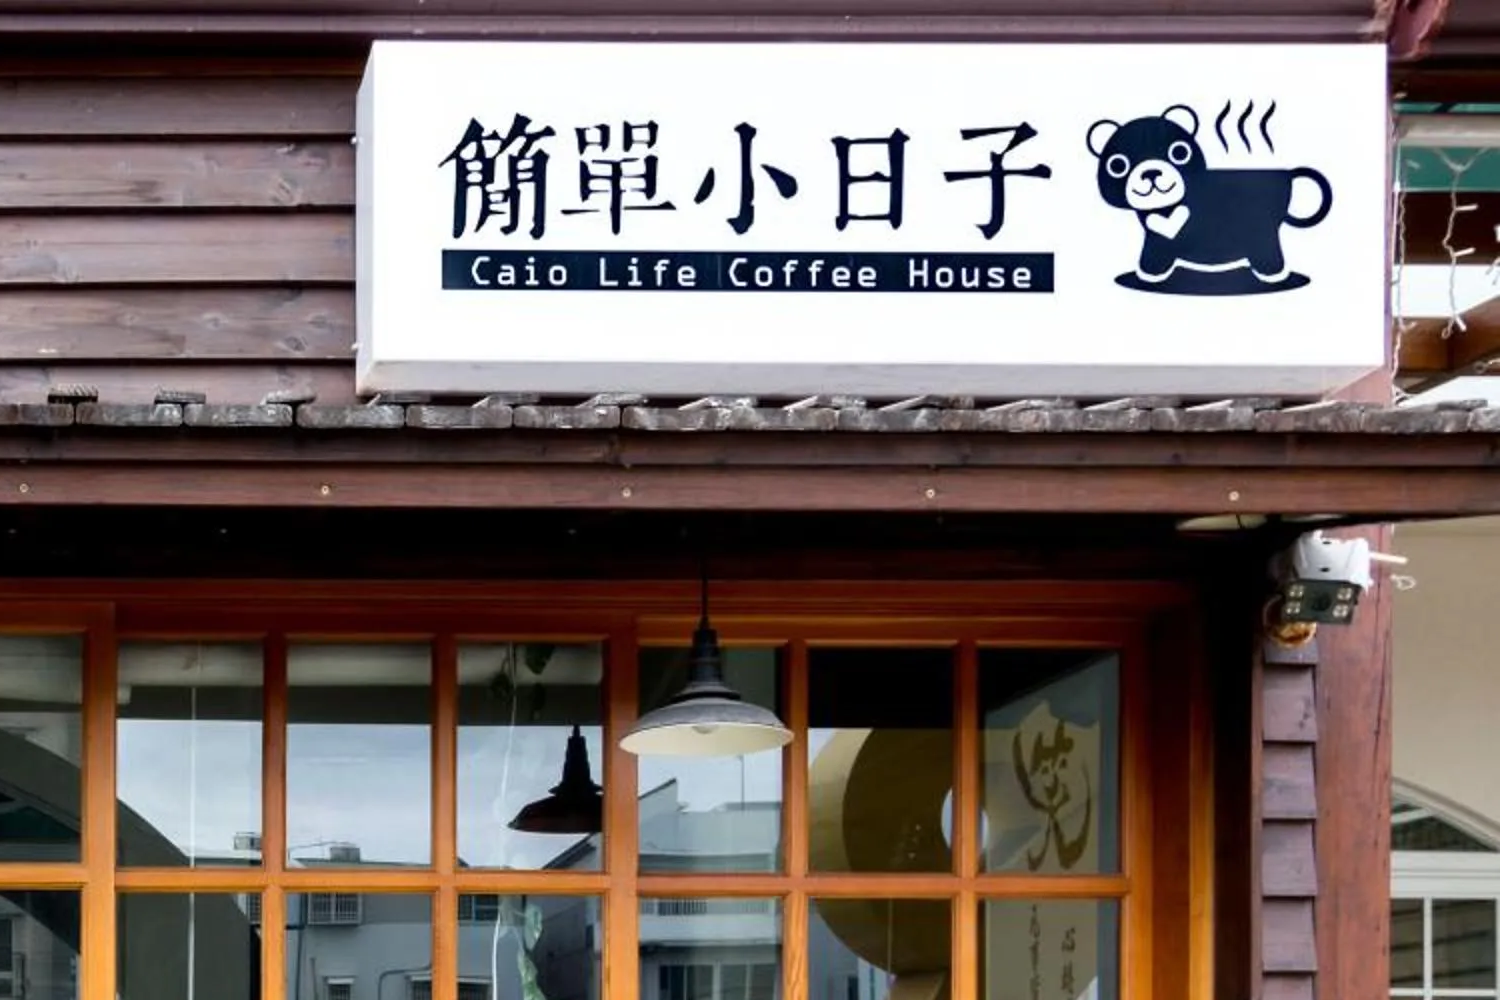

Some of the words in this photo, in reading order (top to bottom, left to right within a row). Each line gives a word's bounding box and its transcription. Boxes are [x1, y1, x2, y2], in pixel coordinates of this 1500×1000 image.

[438, 112, 1052, 241] 簡單小日子
[471, 257, 567, 287] Caio
[599, 257, 696, 287] Life
[728, 258, 877, 287] Coffee
[910, 258, 1032, 288] House
